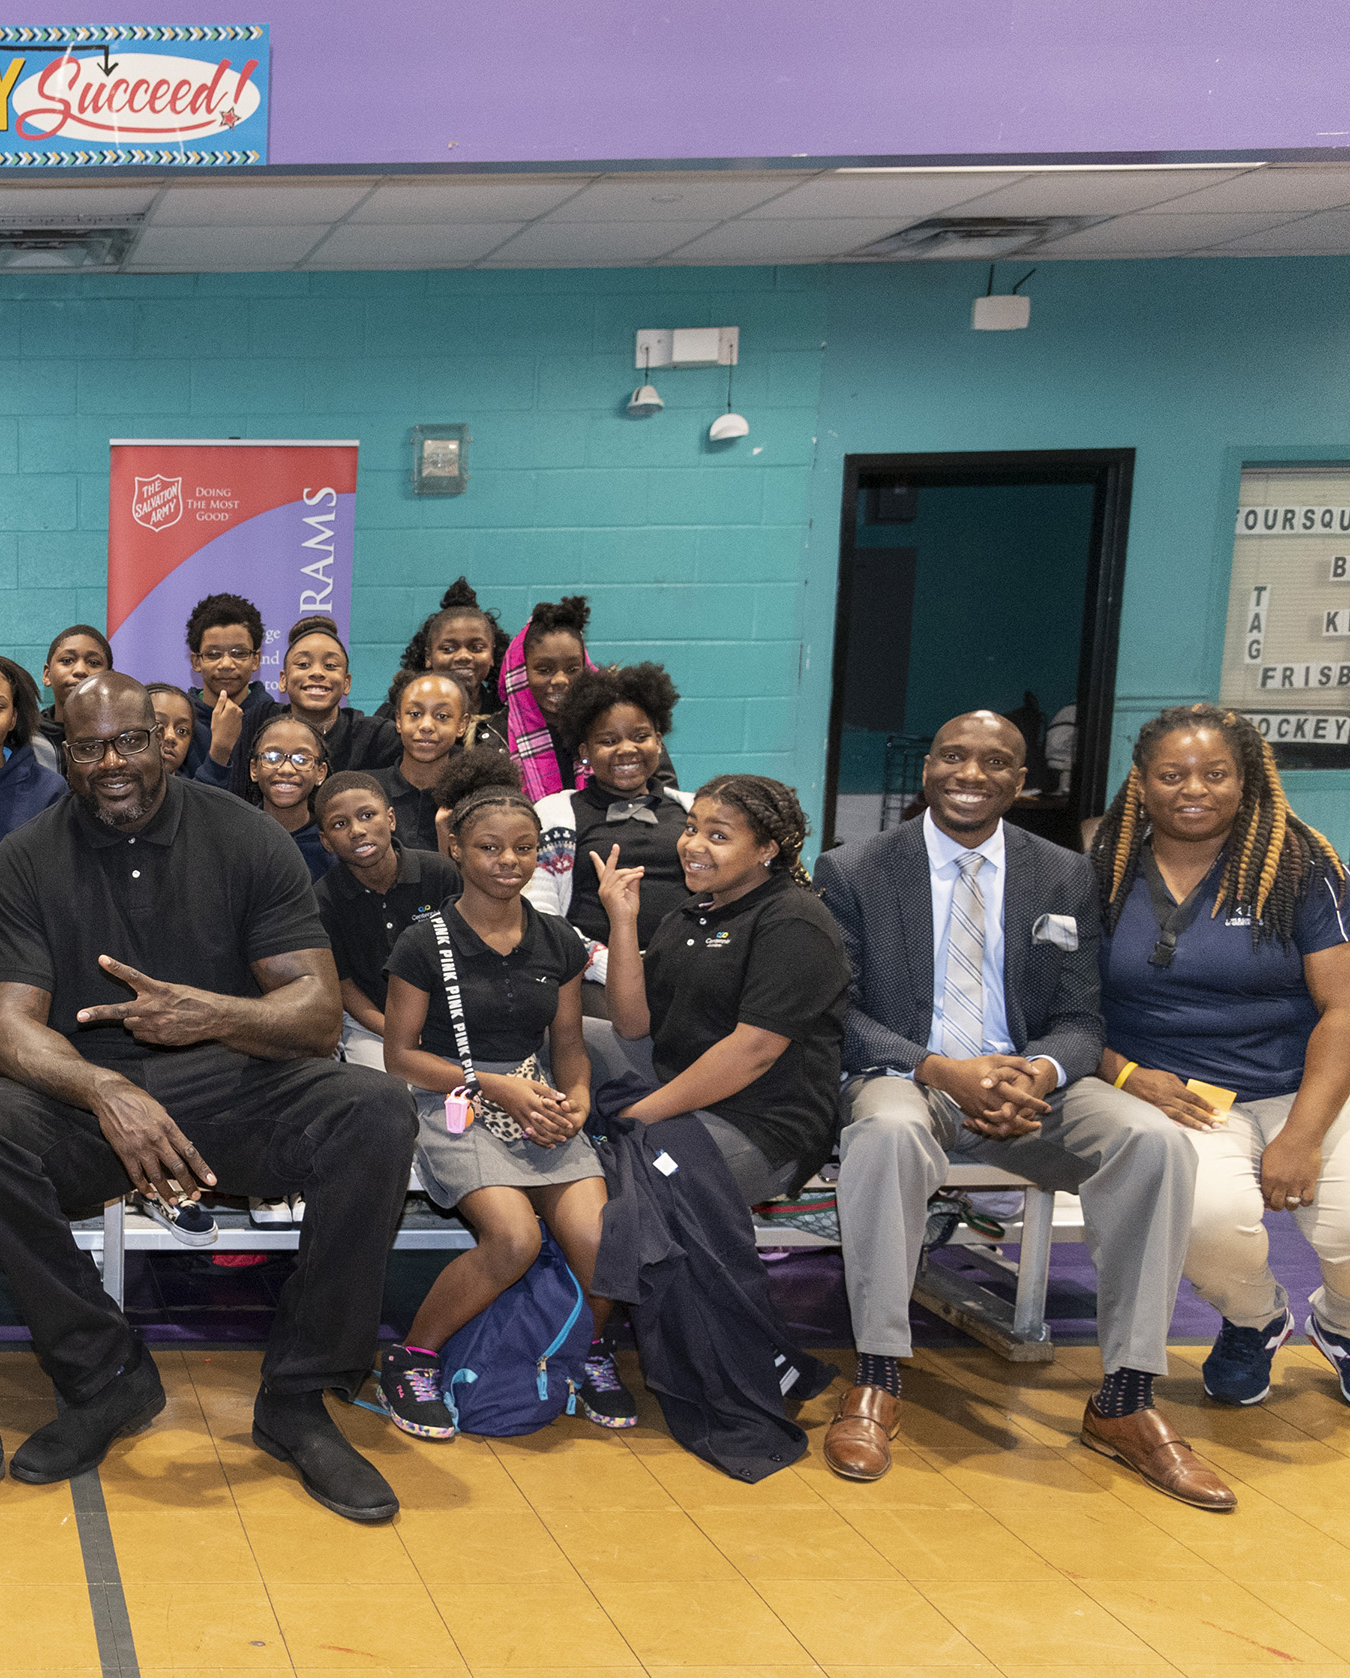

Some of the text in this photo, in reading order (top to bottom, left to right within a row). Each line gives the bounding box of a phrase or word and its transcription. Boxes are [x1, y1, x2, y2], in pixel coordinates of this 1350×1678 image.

[135, 482, 178, 518] SALVATION
[142, 480, 162, 499] THE
[150, 498, 176, 525] ARMY
[1237, 508, 1350, 531] OURSQU
[1248, 585, 1268, 660] TAG
[1250, 717, 1347, 740] OCKEY
[430, 916, 451, 945] PINK
[439, 949, 458, 982] PINK
[445, 985, 464, 1020] PINK
[453, 1022, 471, 1057] PINK
